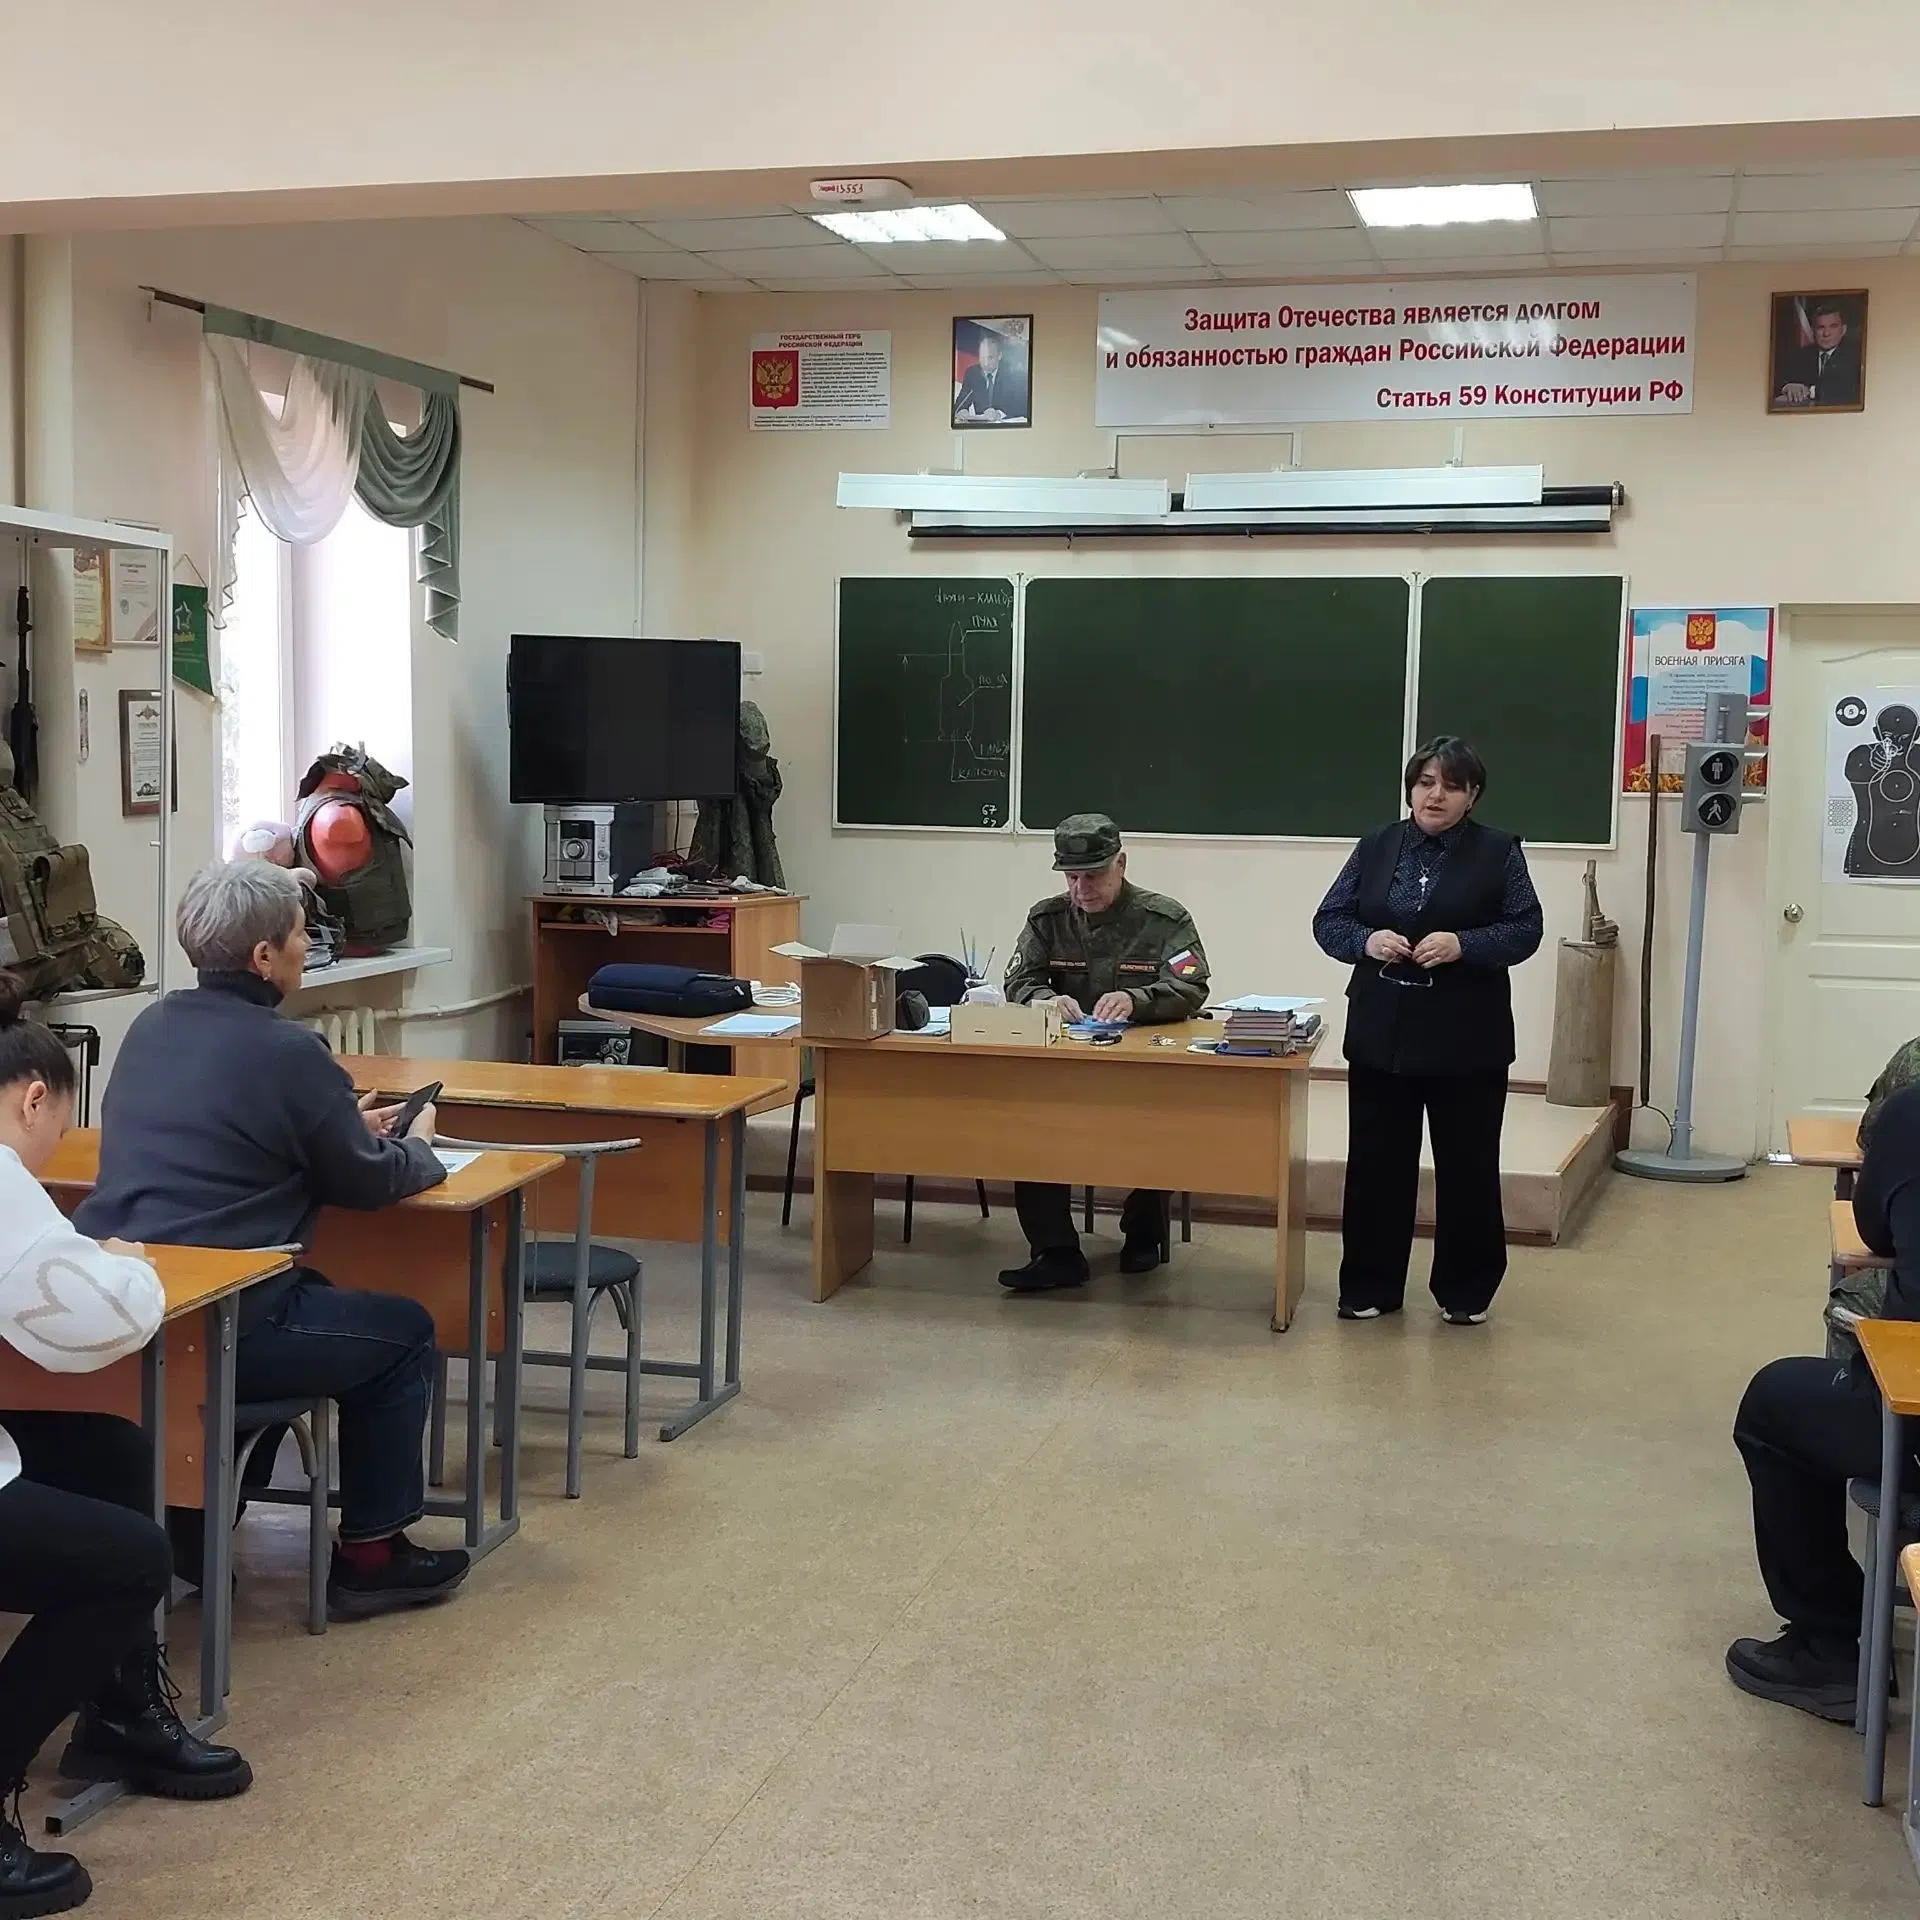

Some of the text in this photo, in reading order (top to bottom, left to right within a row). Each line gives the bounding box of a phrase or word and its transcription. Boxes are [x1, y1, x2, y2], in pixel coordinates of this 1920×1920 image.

[1184, 301, 1600, 333] Защита Отечества является долгом
[780, 333, 844, 341] ГОСУДАРСТВЕННЫЙ
[778, 341, 822, 349] РОССИЙСКОЙ
[1105, 333, 1686, 369] и обязанностью граждан Российской Федерации
[1376, 380, 1684, 408] Статья 59 Конституции РФ
[1654, 655, 1746, 666] ВОЕННАЯ ПРИСЯГА
[981, 804, 998, 816] 67
